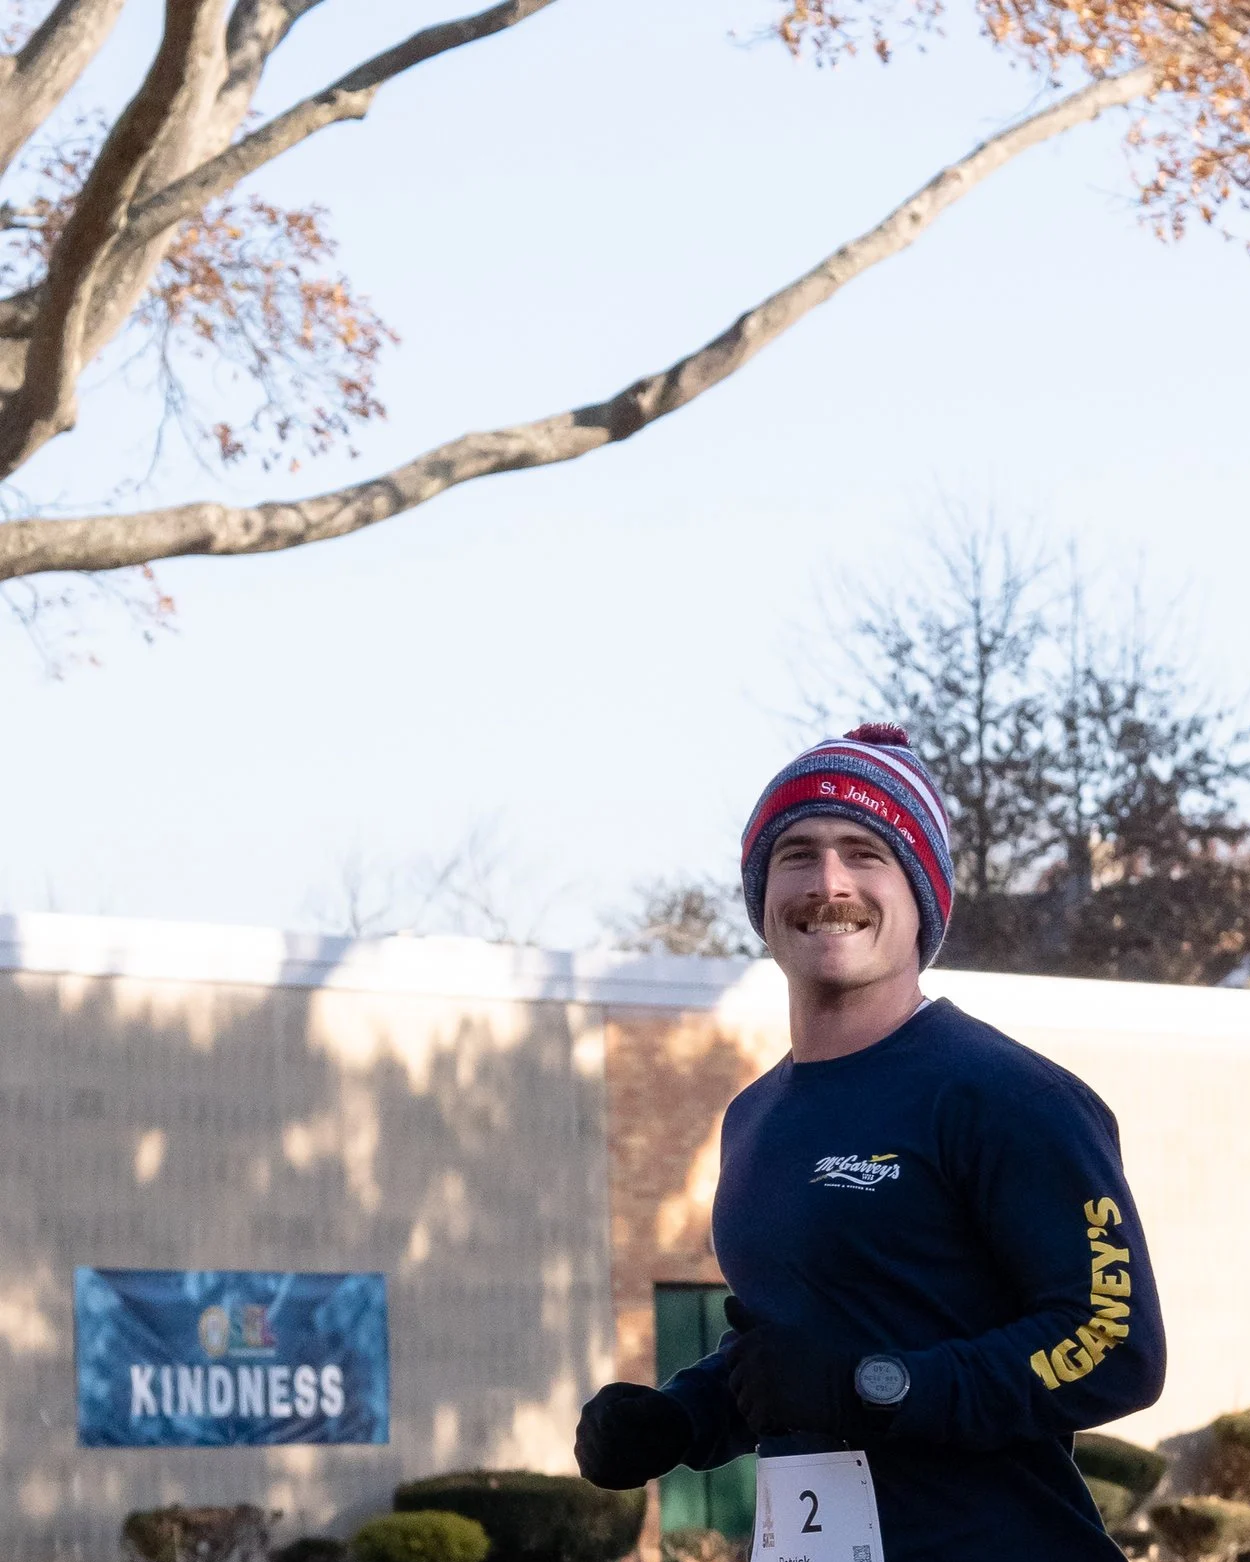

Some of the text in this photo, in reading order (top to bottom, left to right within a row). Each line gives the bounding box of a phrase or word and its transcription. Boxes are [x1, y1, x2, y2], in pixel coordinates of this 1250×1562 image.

[844, 785, 889, 818] John's
[892, 813, 916, 845] Law
[813, 1154, 901, 1180] McGarvey's
[129, 1362, 346, 1418] KINDNESS
[798, 1489, 823, 1534] 2
